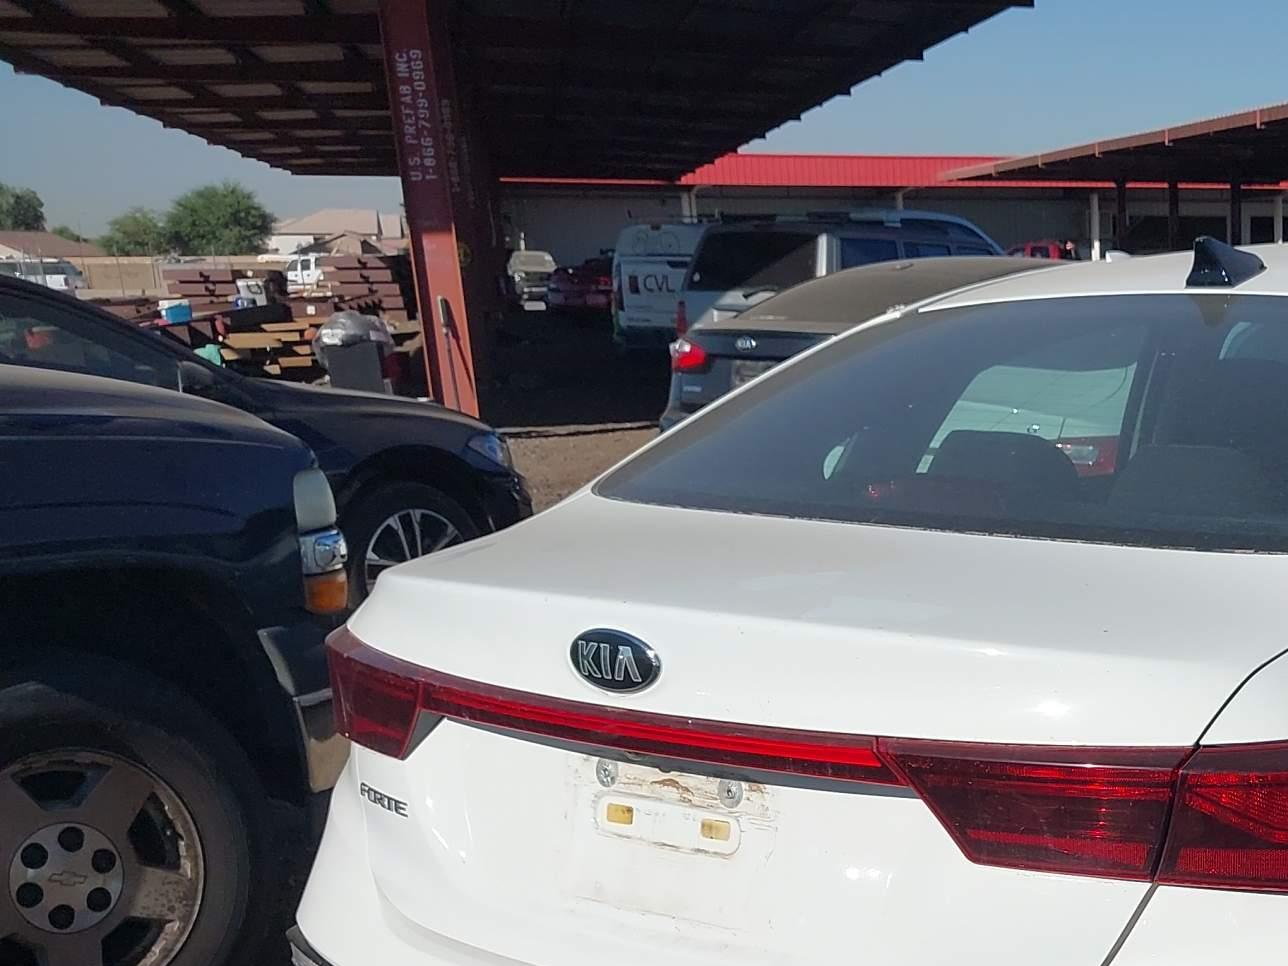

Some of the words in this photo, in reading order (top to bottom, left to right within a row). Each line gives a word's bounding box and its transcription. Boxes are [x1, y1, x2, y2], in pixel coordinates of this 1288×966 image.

[395, 48, 410, 77] INC.
[400, 85, 418, 144] PREFAB
[408, 152, 423, 181] U.S.
[643, 274, 676, 293] CVL
[578, 640, 642, 682] KIA
[360, 782, 409, 818] FORTE
